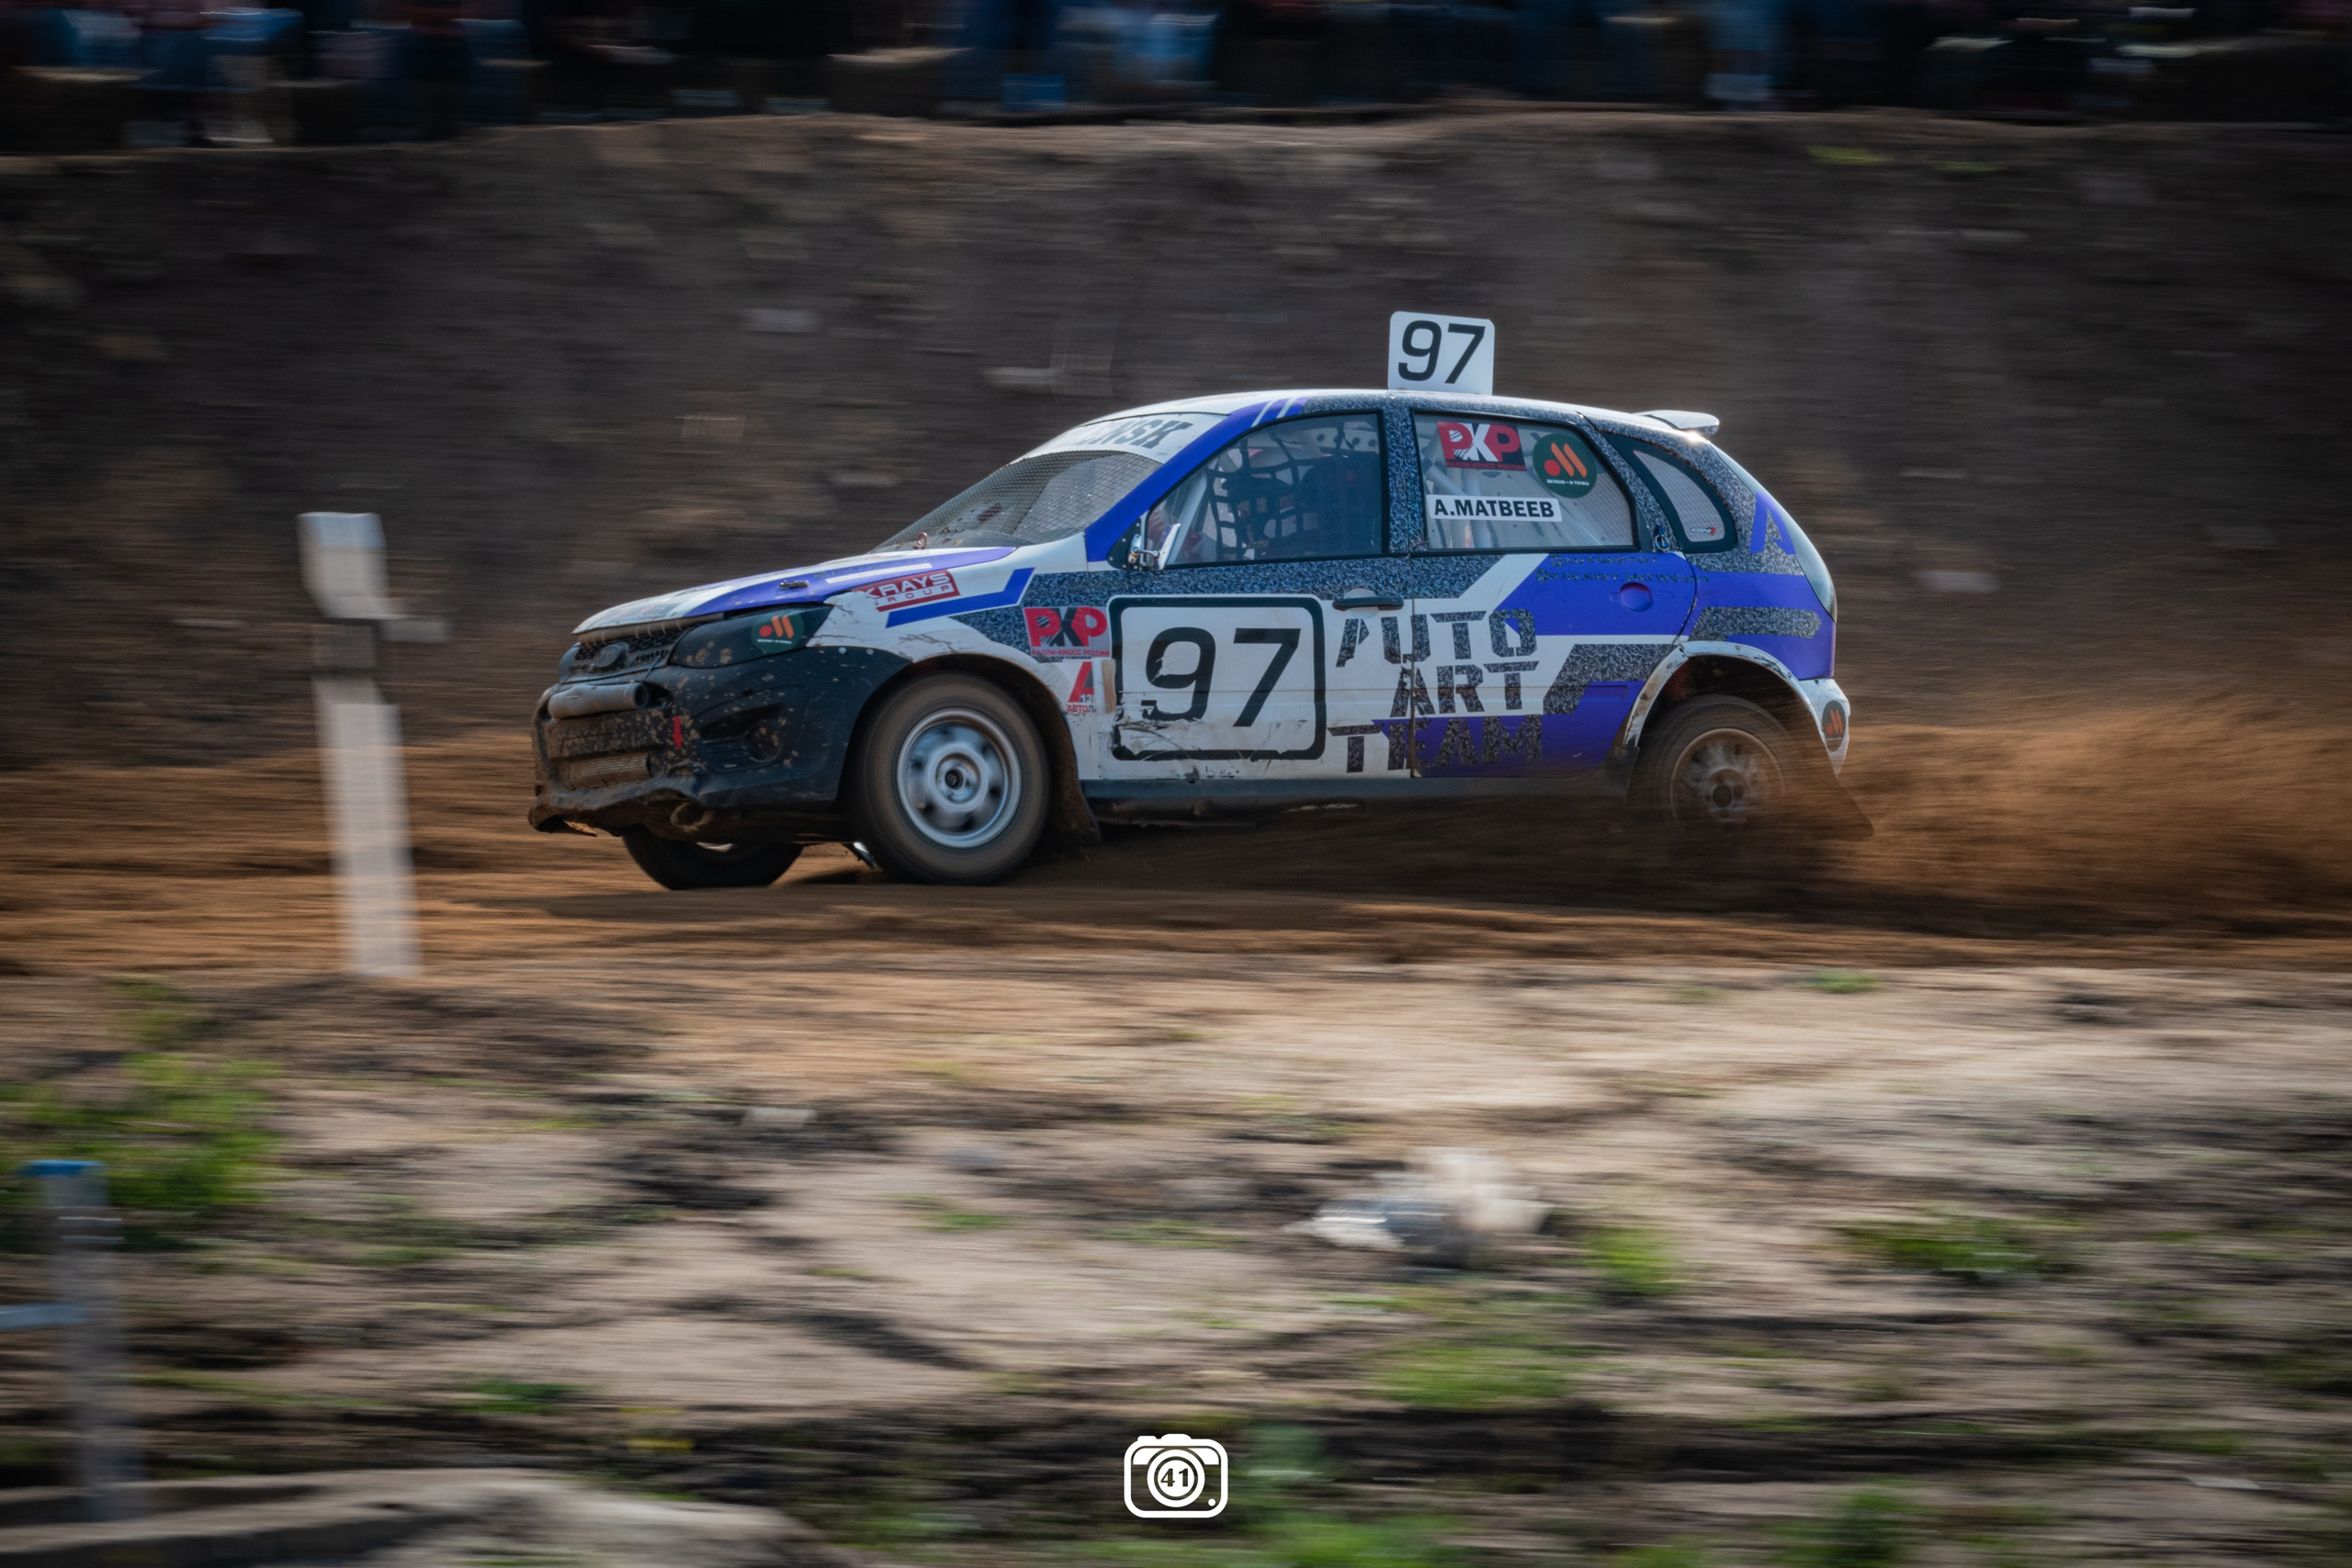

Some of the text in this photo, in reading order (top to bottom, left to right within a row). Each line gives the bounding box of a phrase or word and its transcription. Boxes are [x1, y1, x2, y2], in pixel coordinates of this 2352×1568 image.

[1397, 320, 1486, 384] 97
[1434, 499, 1555, 518] А.МАТВЕЕВ
[1141, 626, 1301, 728] 97
[1390, 660, 1540, 717] ART
[1328, 714, 1543, 773] TEAM
